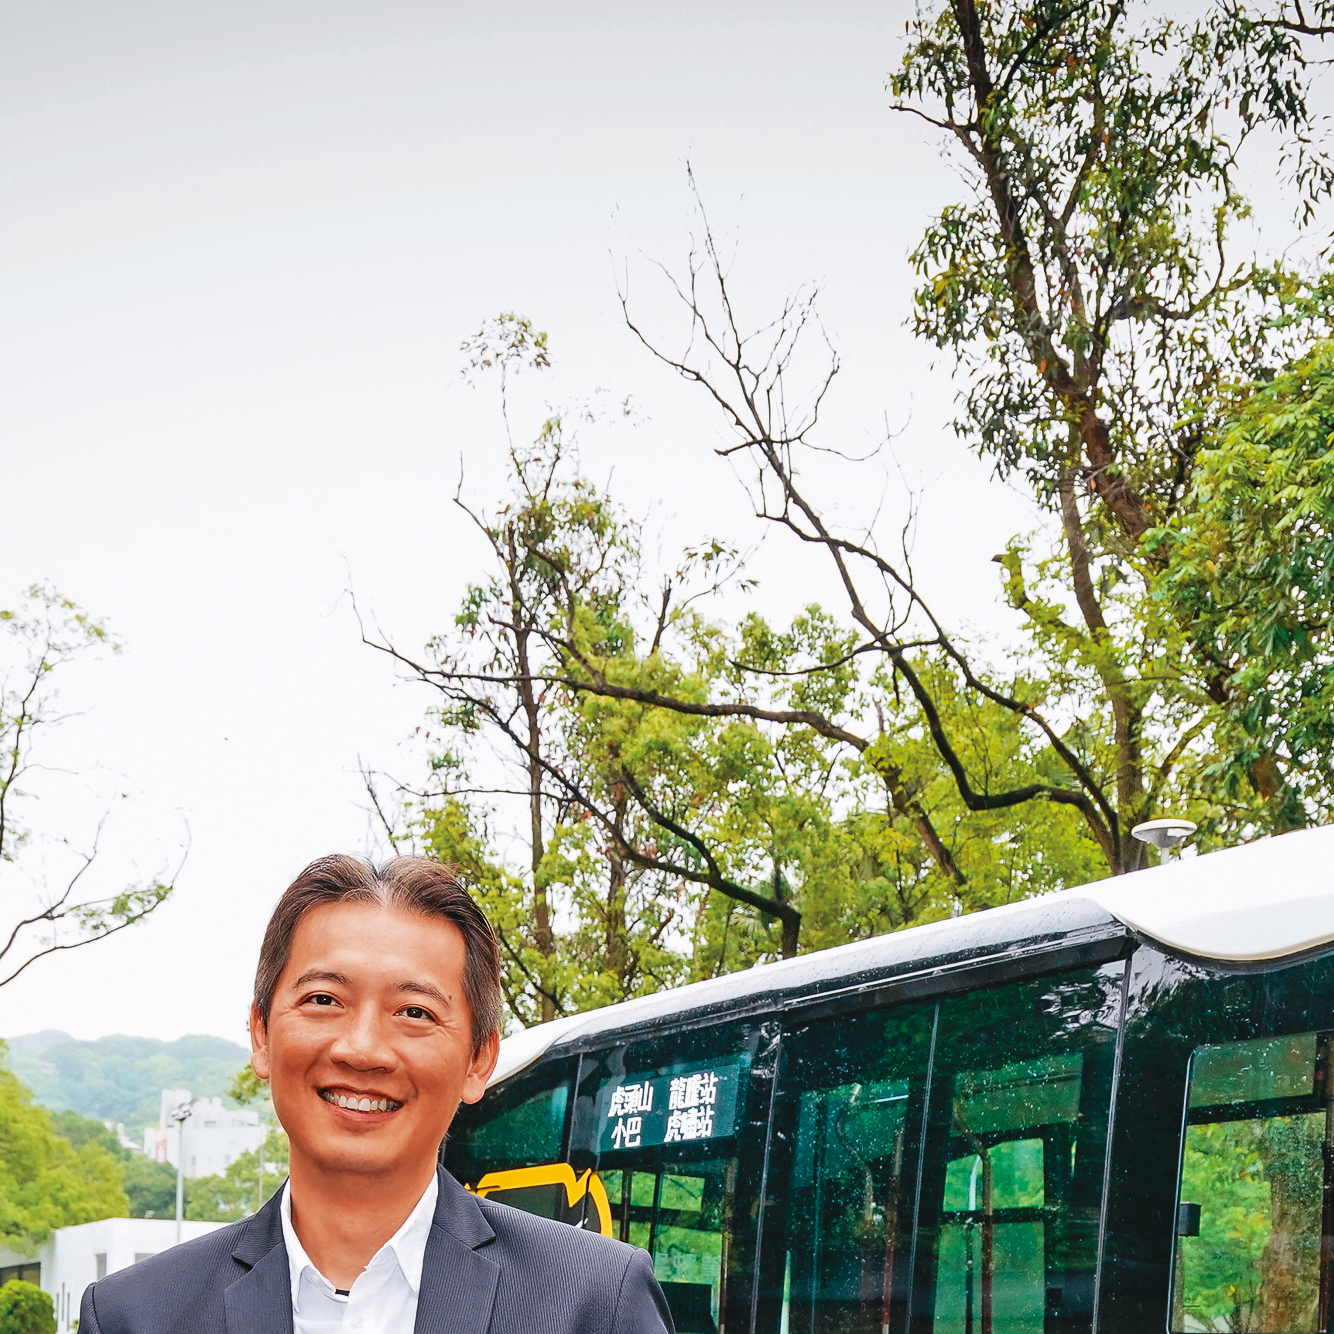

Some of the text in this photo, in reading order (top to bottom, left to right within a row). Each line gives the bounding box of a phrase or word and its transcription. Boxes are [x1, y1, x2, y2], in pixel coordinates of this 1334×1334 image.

[608, 1082, 653, 1117] 虎頭山
[611, 1117, 642, 1149] 小巴
